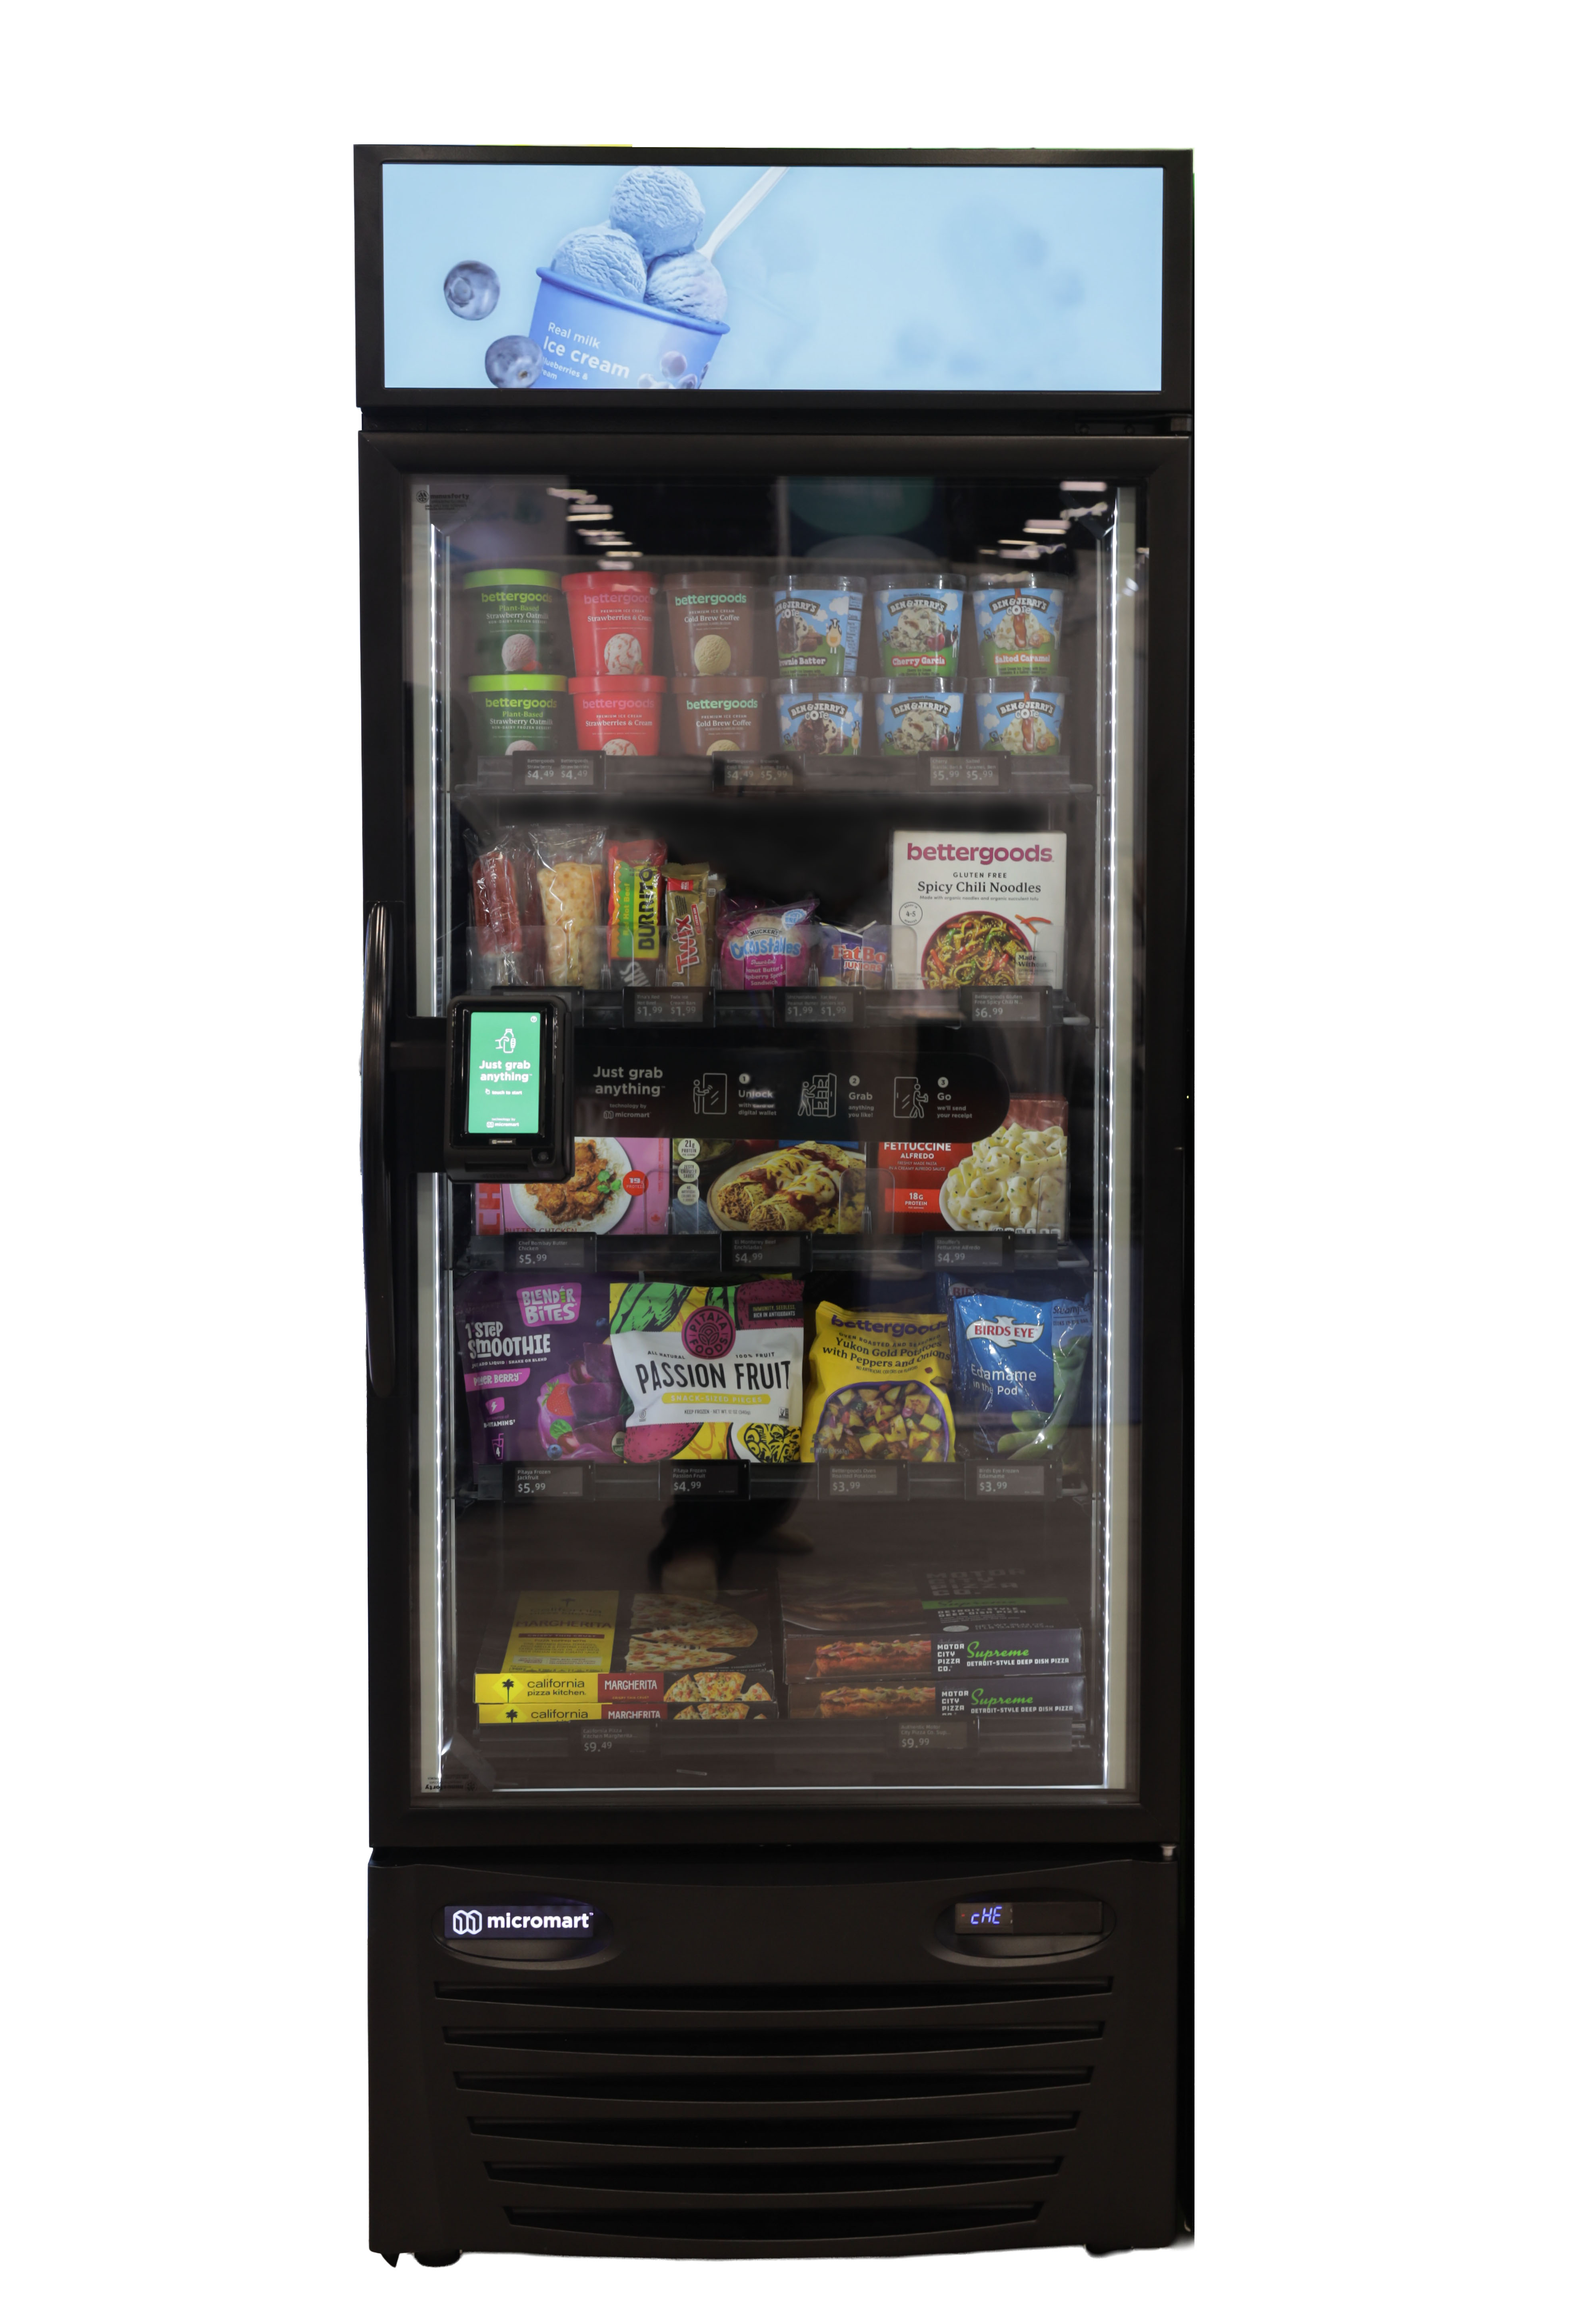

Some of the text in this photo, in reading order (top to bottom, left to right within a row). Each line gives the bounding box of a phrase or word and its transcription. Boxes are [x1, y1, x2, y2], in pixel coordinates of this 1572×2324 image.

[548, 322, 601, 349] Real milk
[543, 336, 630, 379] Ice cream
[481, 591, 553, 603] bettergoods
[675, 593, 747, 606] bettergoods
[890, 601, 907, 613] BEN
[913, 600, 945, 613] JERRY'S
[892, 657, 945, 666] Cherry Garcia
[995, 654, 1050, 664] Salted Caramel
[485, 698, 557, 708] bettergoods
[582, 699, 655, 710] bettergoods
[686, 698, 758, 710] bettergoods
[527, 770, 555, 780] $4.49
[561, 770, 587, 780] $4.49
[727, 771, 754, 780] $4.49
[761, 771, 787, 780] $5.99
[966, 771, 993, 781] $5.99
[907, 843, 1053, 865] bettergoods
[917, 881, 1041, 894] Spicy Chili Noodles
[638, 868, 655, 950] BURRITO
[843, 961, 882, 972] JUNIORS
[637, 1006, 662, 1016] $1.99
[671, 1006, 696, 1016] $1.99
[787, 1007, 813, 1016] $1.99
[821, 1007, 847, 1016] $1.99
[975, 1008, 1003, 1018] $6.99
[479, 1059, 531, 1071] Just grab
[480, 1072, 529, 1083] anything
[593, 1066, 663, 1080] Just grab
[595, 1083, 661, 1097] anything
[738, 1089, 774, 1098] Unlock
[849, 1092, 873, 1100] Grab
[884, 1142, 952, 1151] FETTUCCINE
[519, 1254, 547, 1264] $5.99
[735, 1253, 763, 1263] $4.99
[937, 1253, 965, 1263] $4.99
[690, 1313, 728, 1332] PITAYA
[465, 1323, 472, 1339] 1
[975, 1326, 1035, 1338] BIRDS EYE
[690, 1337, 728, 1355] FOODS
[836, 1337, 942, 1357] Yukon Gold Potatoes
[822, 1346, 951, 1367] with Peppers and Onions
[635, 1360, 791, 1394] PASSION FRUIT
[971, 1364, 1037, 1382] Edamame
[973, 1379, 1018, 1395] in the Pod
[517, 1482, 546, 1494] $5.99
[673, 1481, 701, 1492] $4.99
[832, 1482, 861, 1492] $3.99
[980, 1481, 1007, 1492] $3.99
[967, 1641, 1029, 1661] Supreme
[527, 1679, 585, 1688] california
[605, 1680, 657, 1690] MARGHERITA
[971, 1688, 1033, 1708] Supreme
[531, 1709, 588, 1718] california
[584, 1742, 612, 1753] $9.49
[902, 1738, 929, 1748] $9.99
[487, 1912, 589, 1929] micromart
